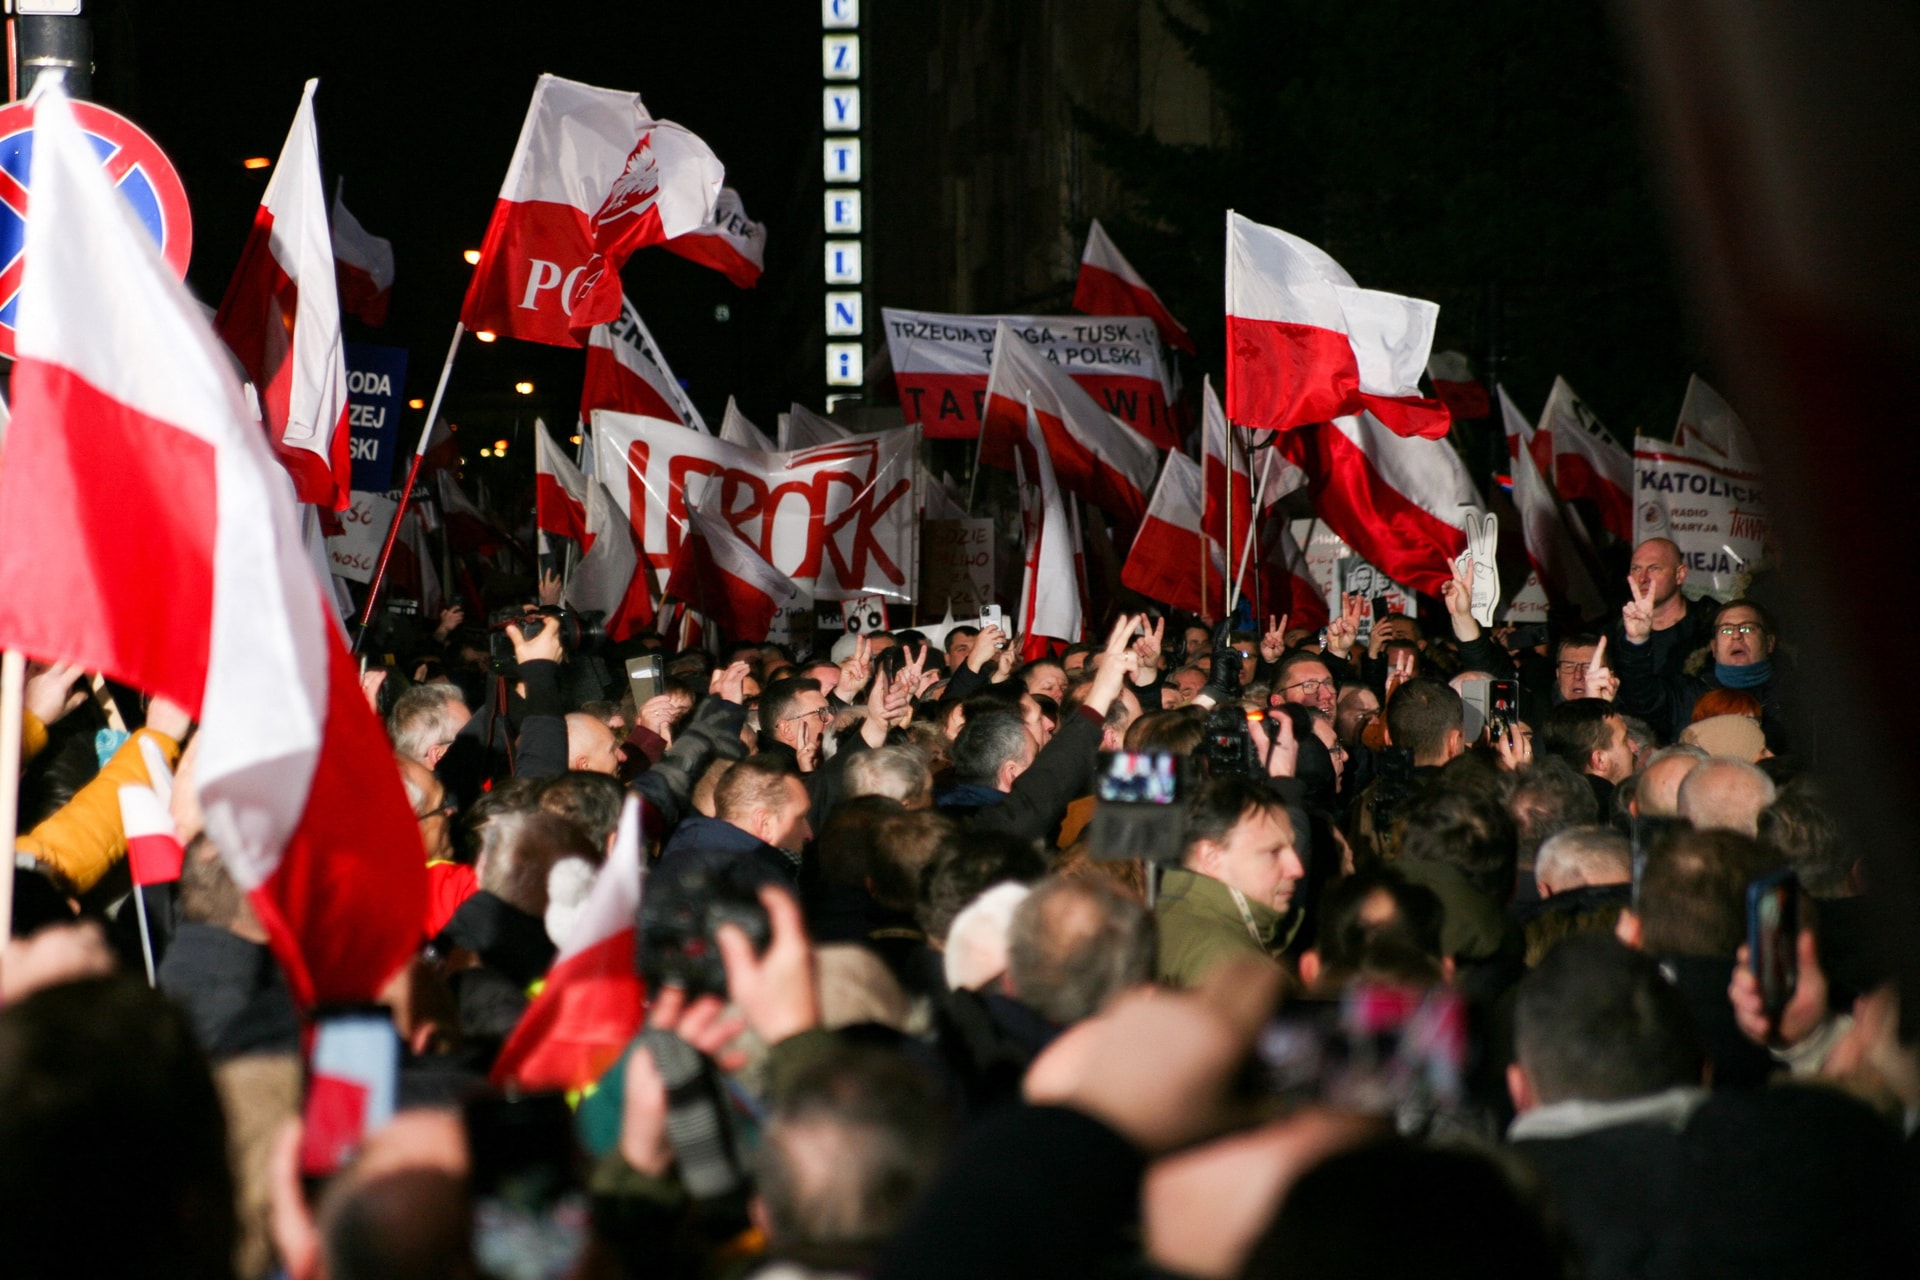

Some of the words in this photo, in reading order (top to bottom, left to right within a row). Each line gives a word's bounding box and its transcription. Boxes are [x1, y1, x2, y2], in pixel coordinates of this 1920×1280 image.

[890, 321, 976, 343] TRZECIA
[978, 328, 1056, 344] DGA
[1073, 324, 1132, 343] TUSK
[1067, 347, 1141, 366] POLSKI
[346, 370, 392, 397] ODA
[349, 403, 386, 429] ZEJ
[349, 436, 379, 461] SKI
[1640, 469, 1765, 505] KATOLICK
[1671, 508, 1708, 518] RADIO
[1670, 522, 1718, 533] MARYJA
